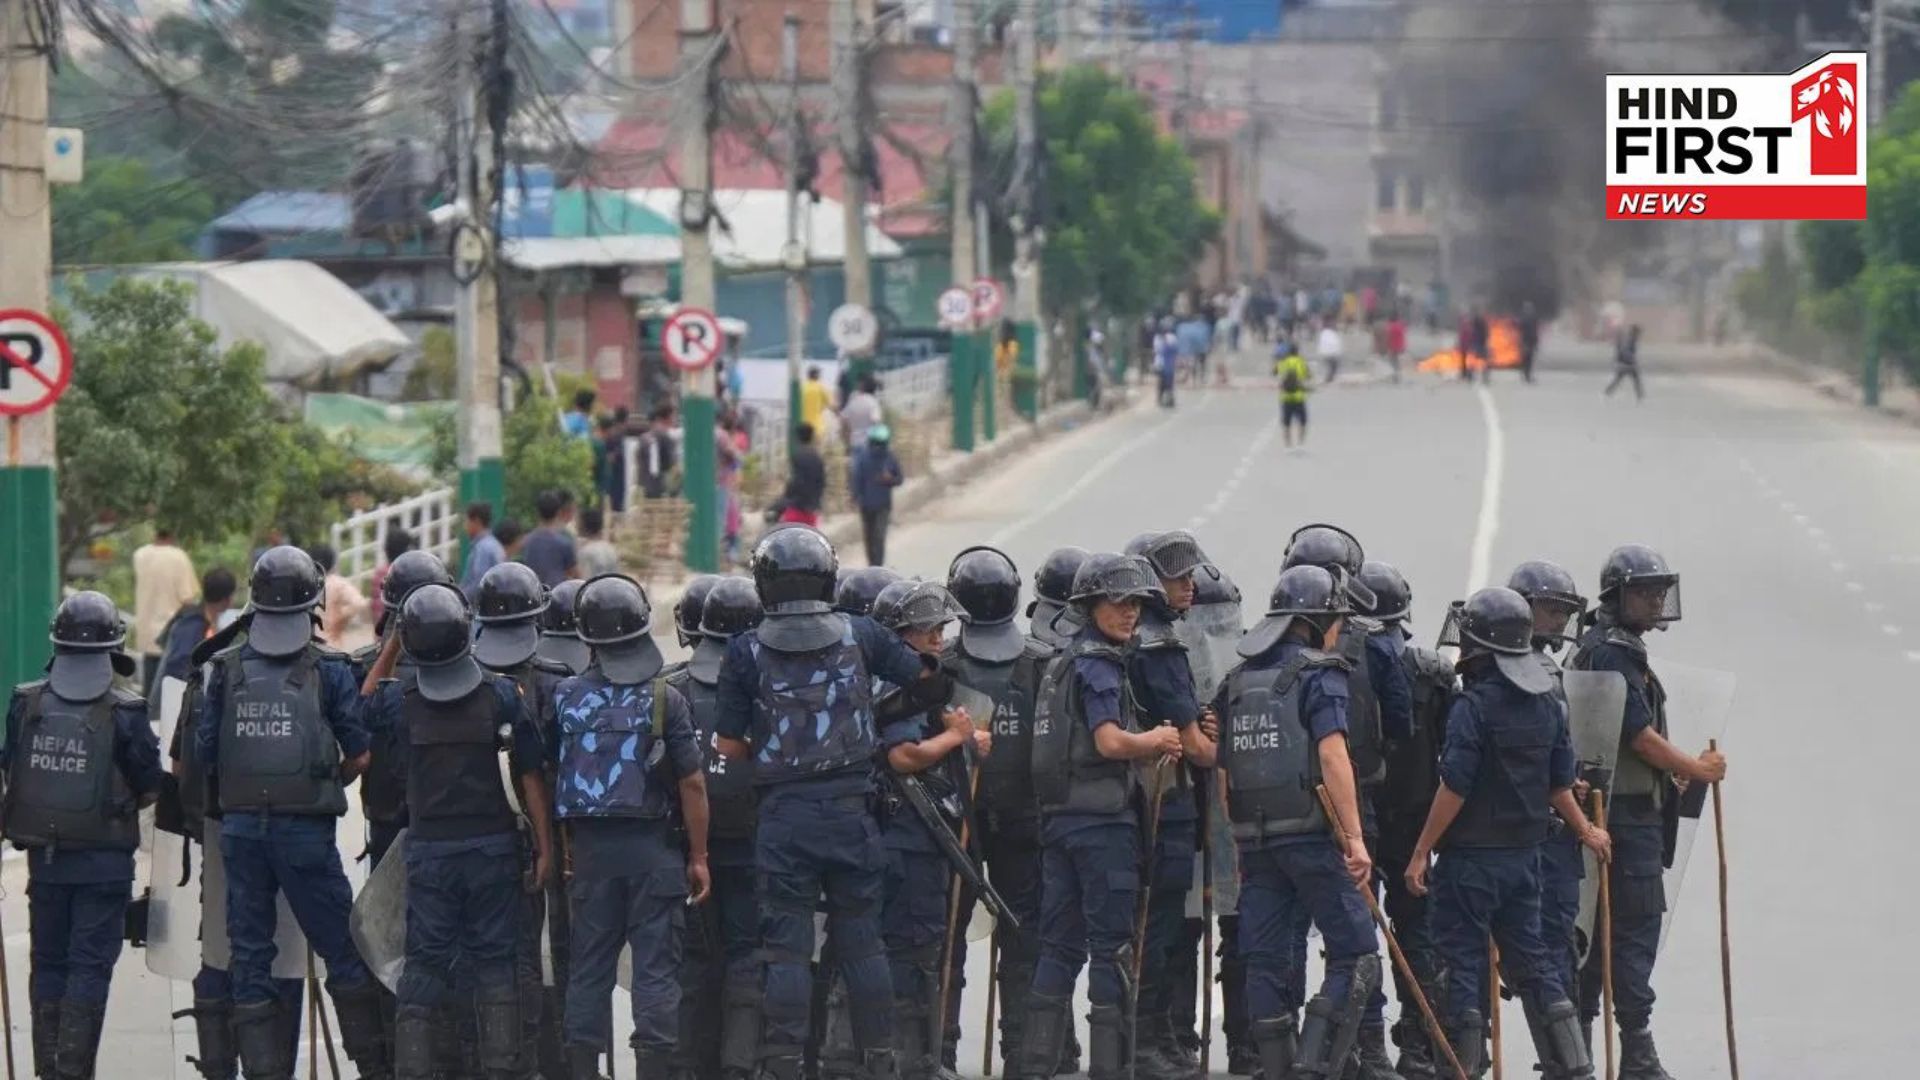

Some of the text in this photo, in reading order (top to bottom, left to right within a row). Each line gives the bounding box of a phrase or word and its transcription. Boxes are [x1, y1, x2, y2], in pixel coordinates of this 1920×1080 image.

[681, 322, 706, 354] P
[0, 333, 42, 390] P
[236, 702, 291, 718] NEPAL
[236, 721, 292, 737] POLICE
[993, 720, 1019, 736] ICE
[1232, 713, 1278, 733] NEPAL
[32, 734, 87, 755] NEPAL
[1233, 732, 1279, 752] POLICE
[30, 753, 87, 773] POLICE
